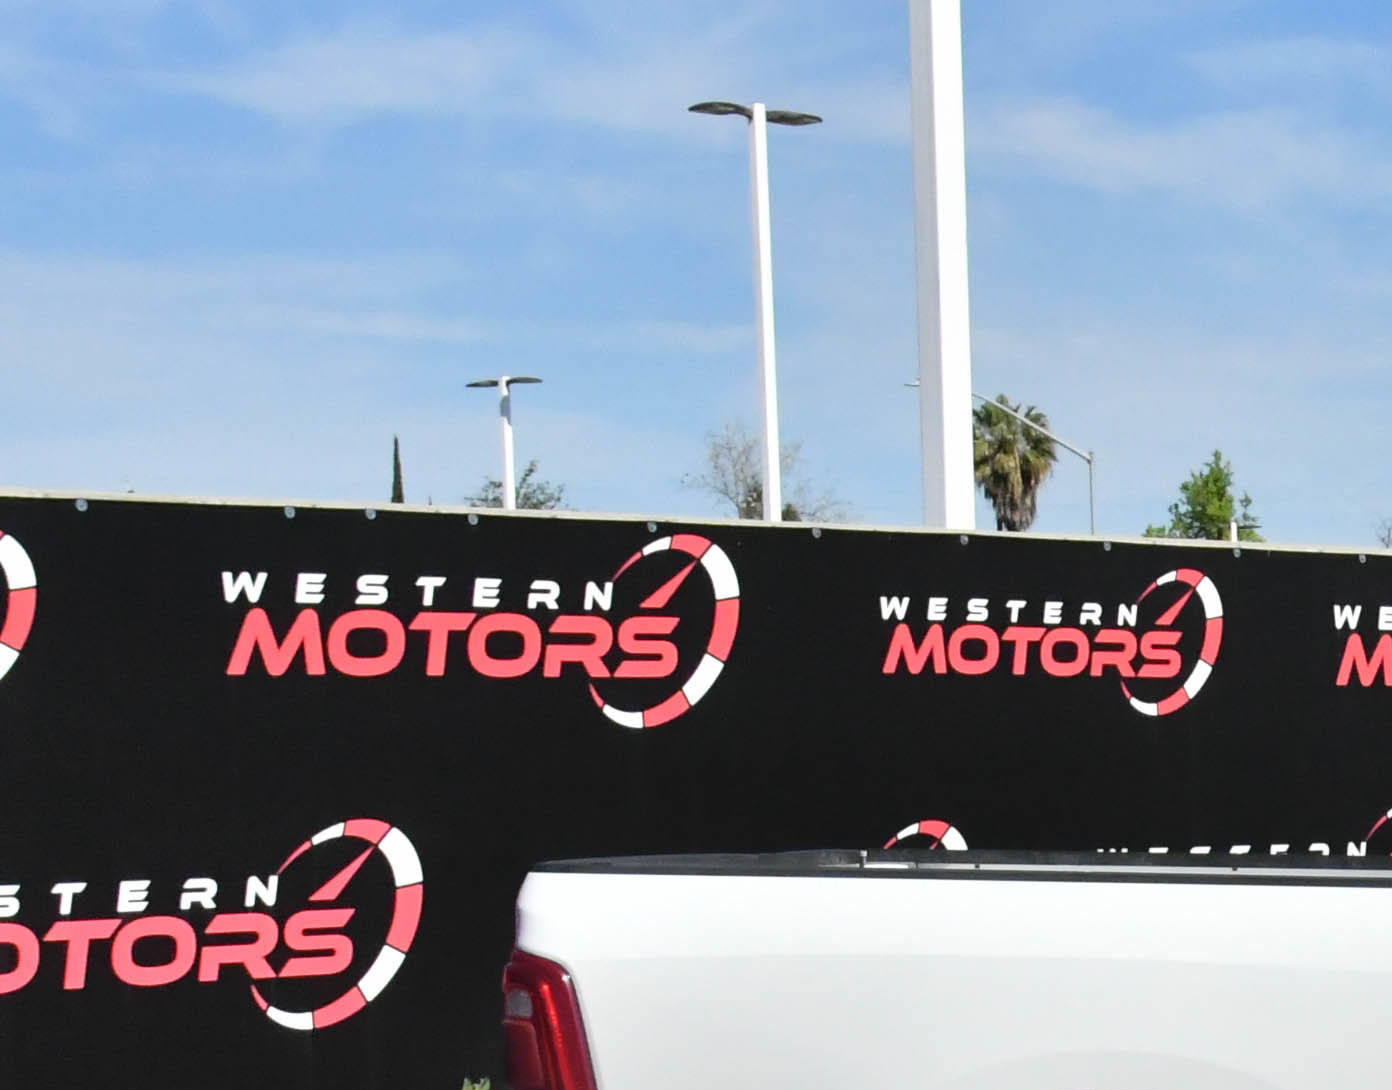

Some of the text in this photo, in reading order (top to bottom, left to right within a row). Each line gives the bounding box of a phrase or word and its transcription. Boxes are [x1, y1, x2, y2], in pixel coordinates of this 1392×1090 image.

[221, 571, 614, 611] WESTERN
[879, 596, 1138, 627] WESTERN
[225, 607, 681, 679] MOTORS
[882, 622, 1183, 679] MOTORS
